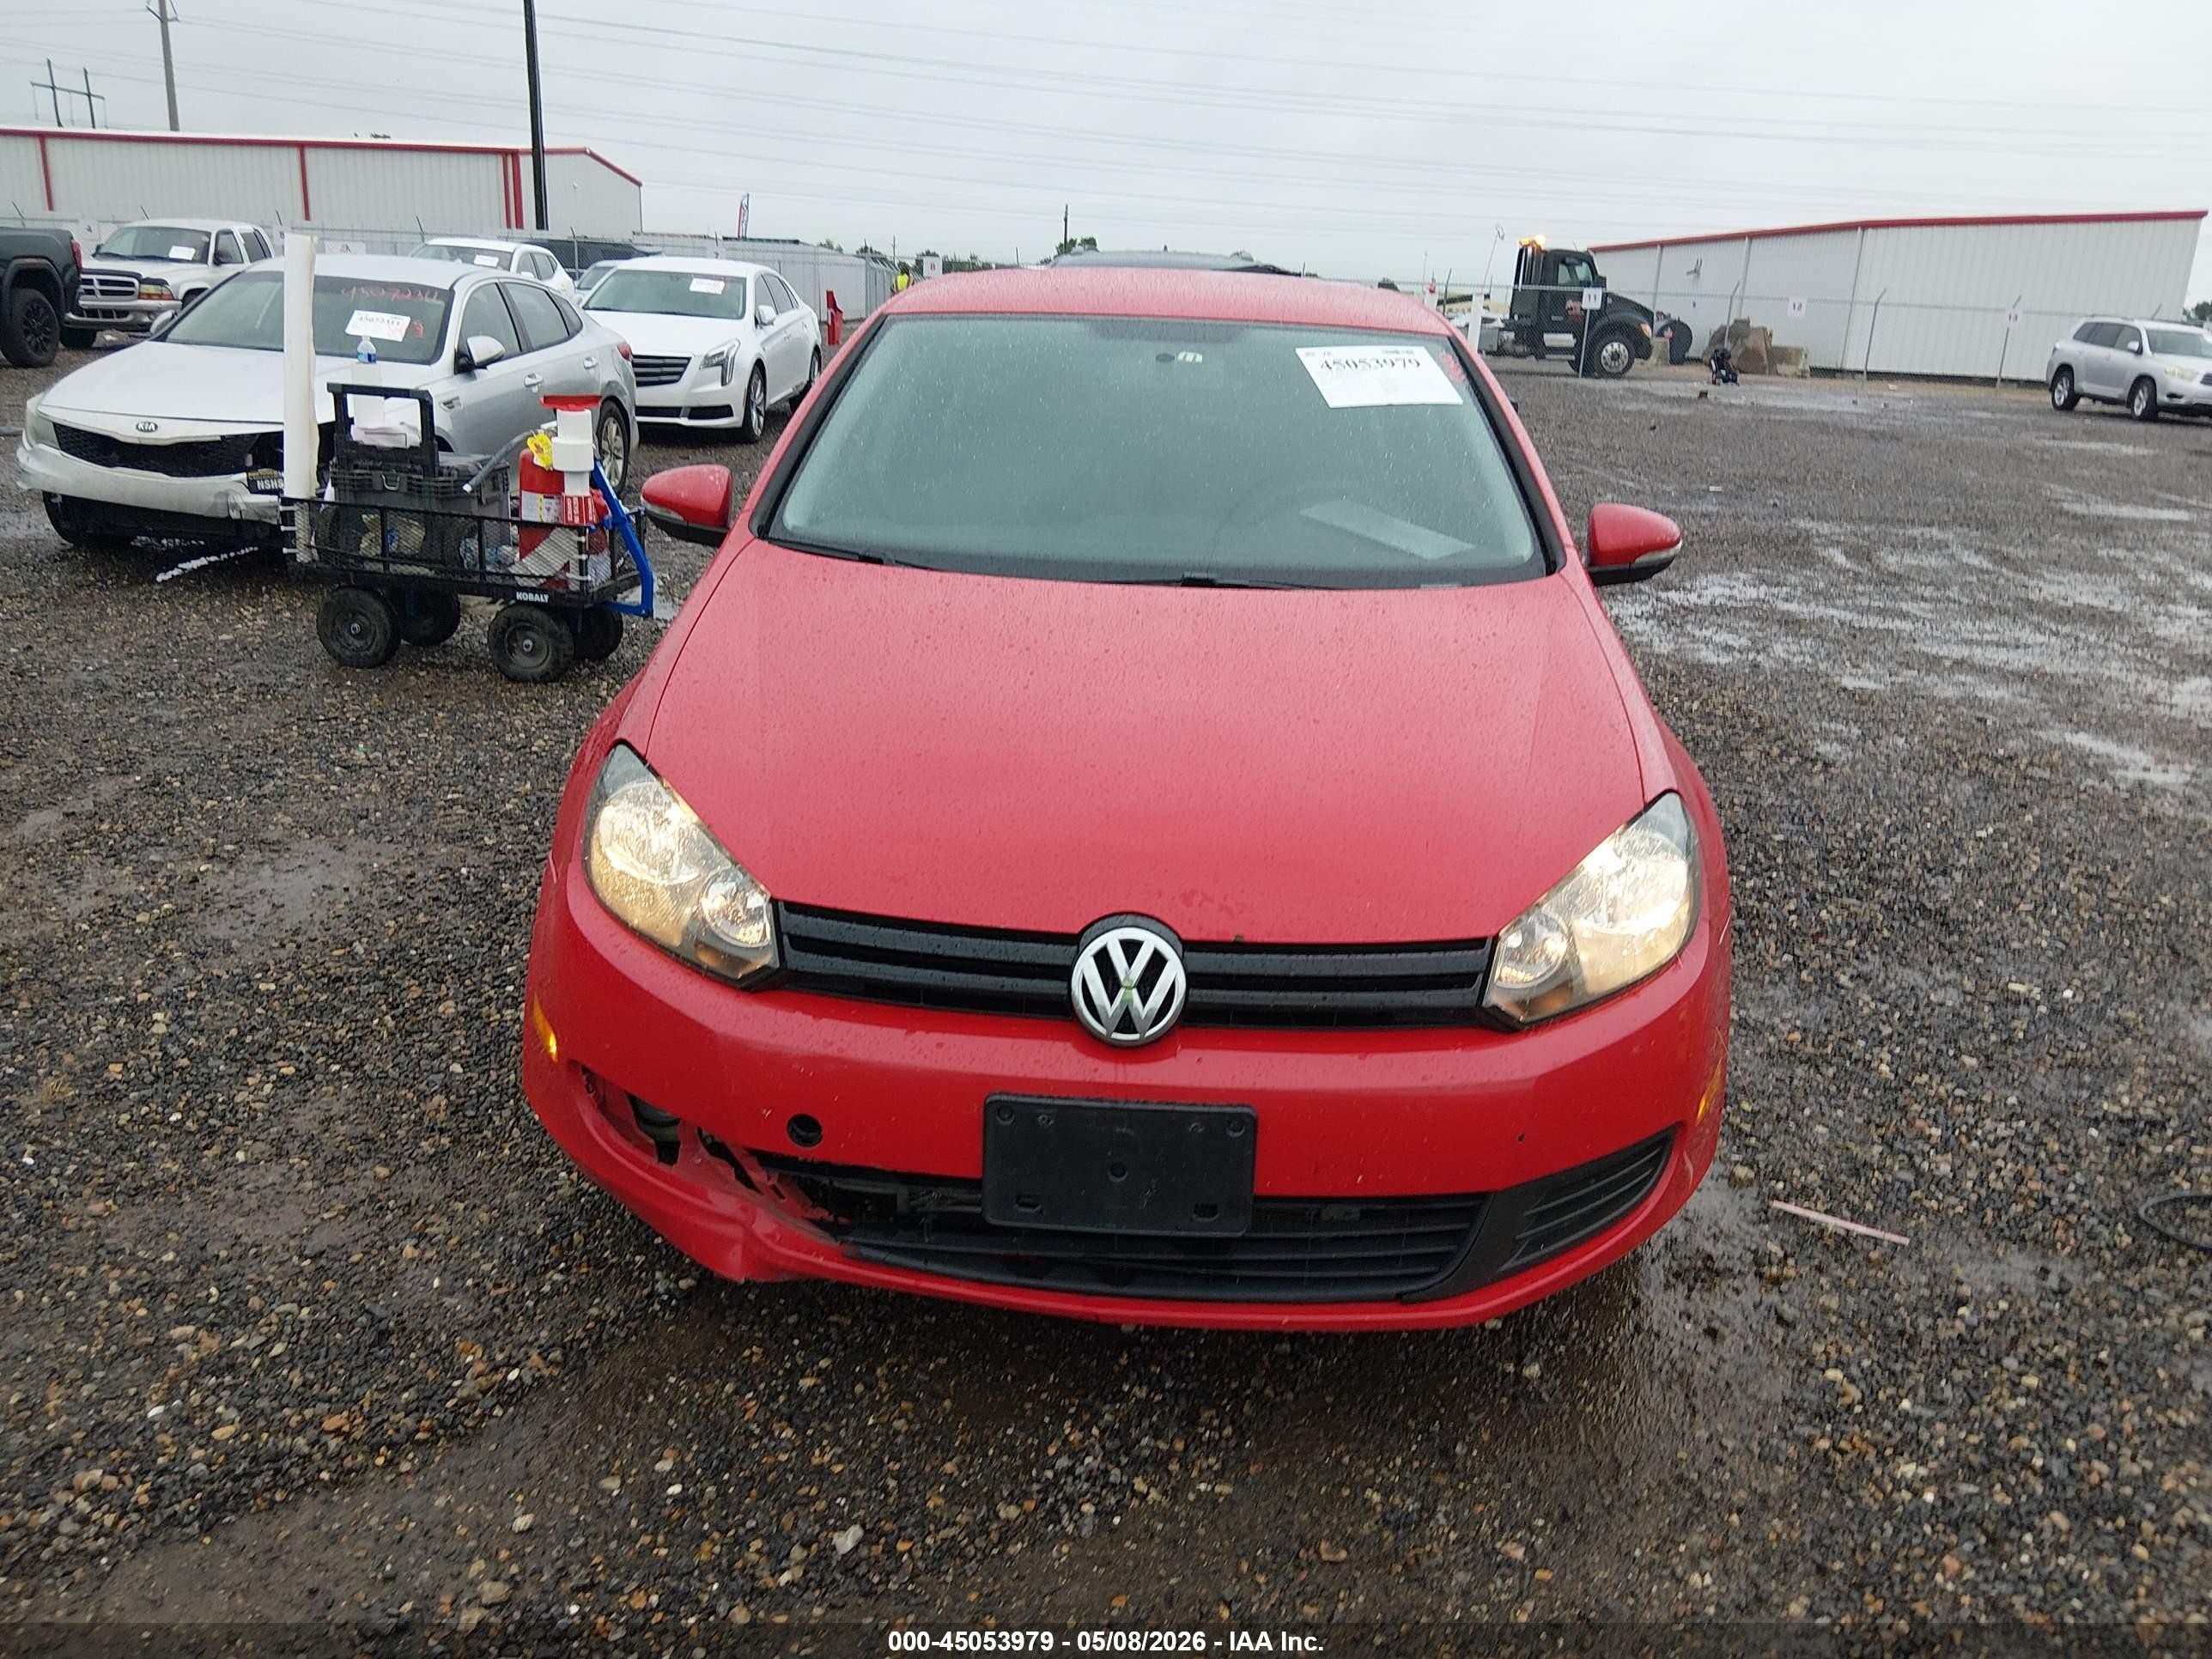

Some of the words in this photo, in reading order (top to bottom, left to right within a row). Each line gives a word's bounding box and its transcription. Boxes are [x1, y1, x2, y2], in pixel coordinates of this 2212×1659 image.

[1321, 357, 1421, 372] 45053979
[137, 422, 156, 432] KIA
[516, 592, 549, 603] KOBALT
